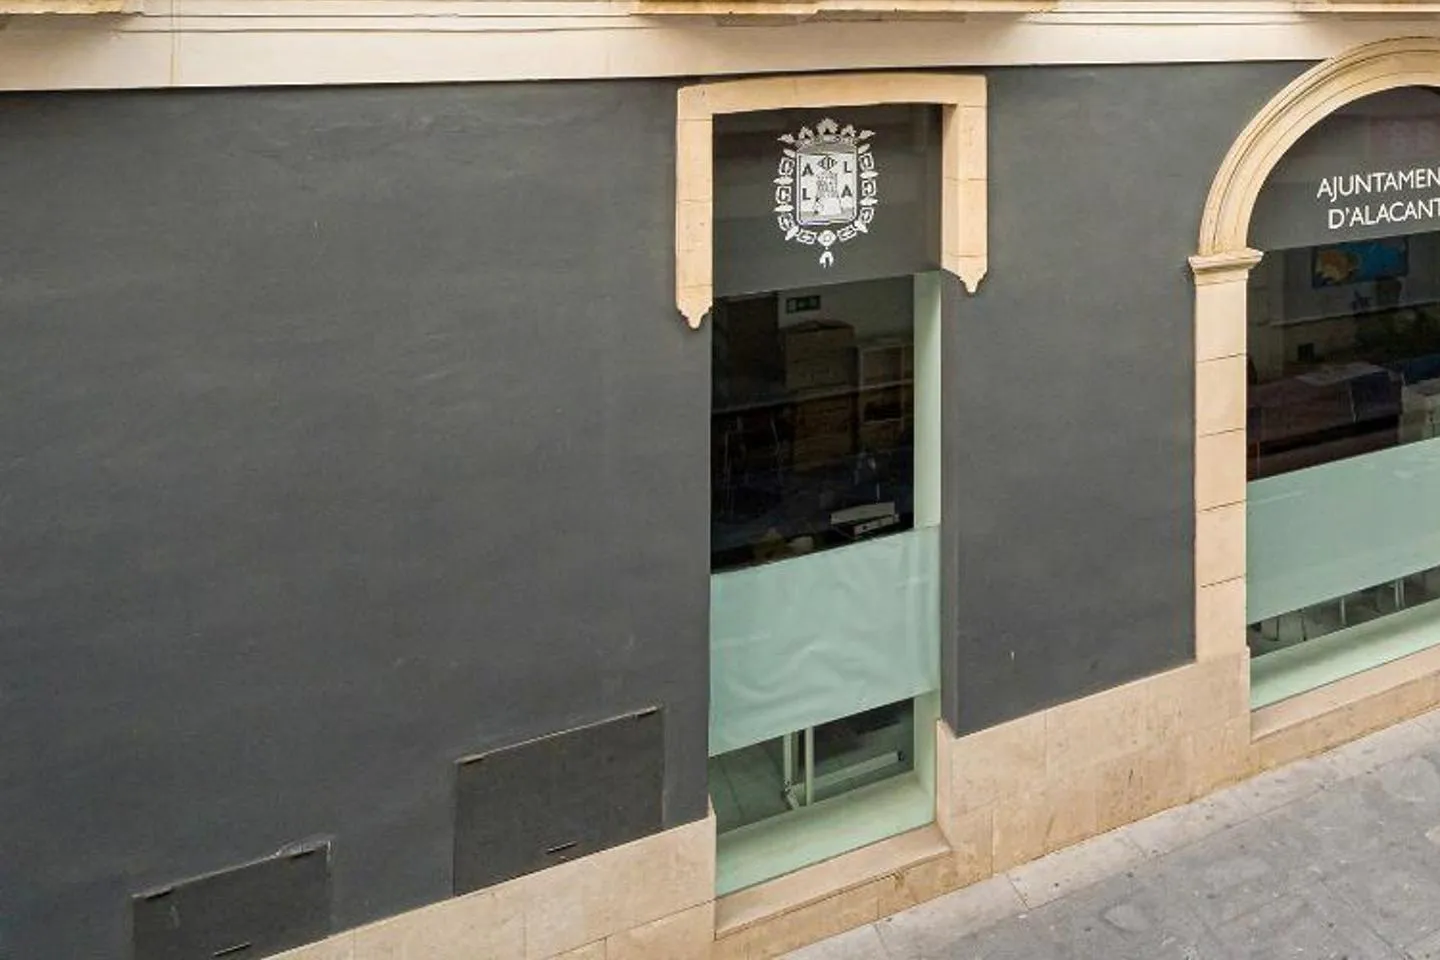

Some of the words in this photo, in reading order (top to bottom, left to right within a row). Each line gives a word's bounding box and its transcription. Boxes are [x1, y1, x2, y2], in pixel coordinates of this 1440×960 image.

[802, 163, 814, 176] A
[843, 160, 853, 173] L
[840, 184, 853, 198] A
